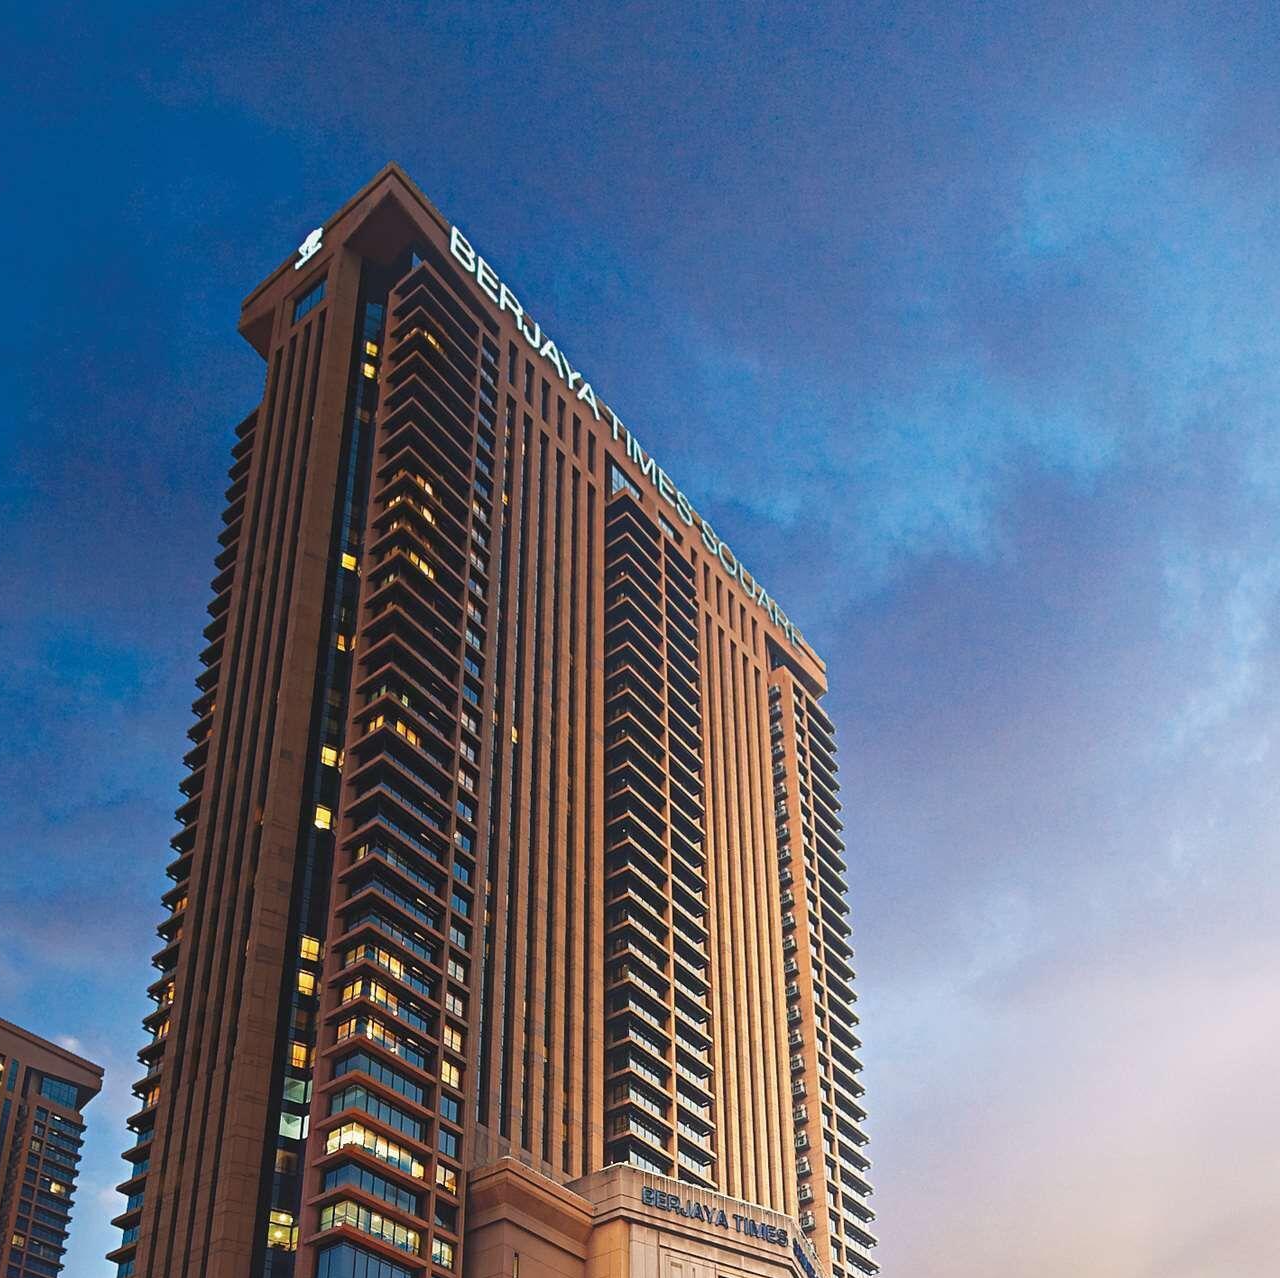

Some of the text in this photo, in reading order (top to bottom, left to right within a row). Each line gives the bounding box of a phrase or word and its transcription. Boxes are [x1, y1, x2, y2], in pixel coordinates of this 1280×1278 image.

[450, 226, 804, 653] BERJAYA TIMES SQUARE
[641, 1185, 789, 1247] BERJAYA TIMES
